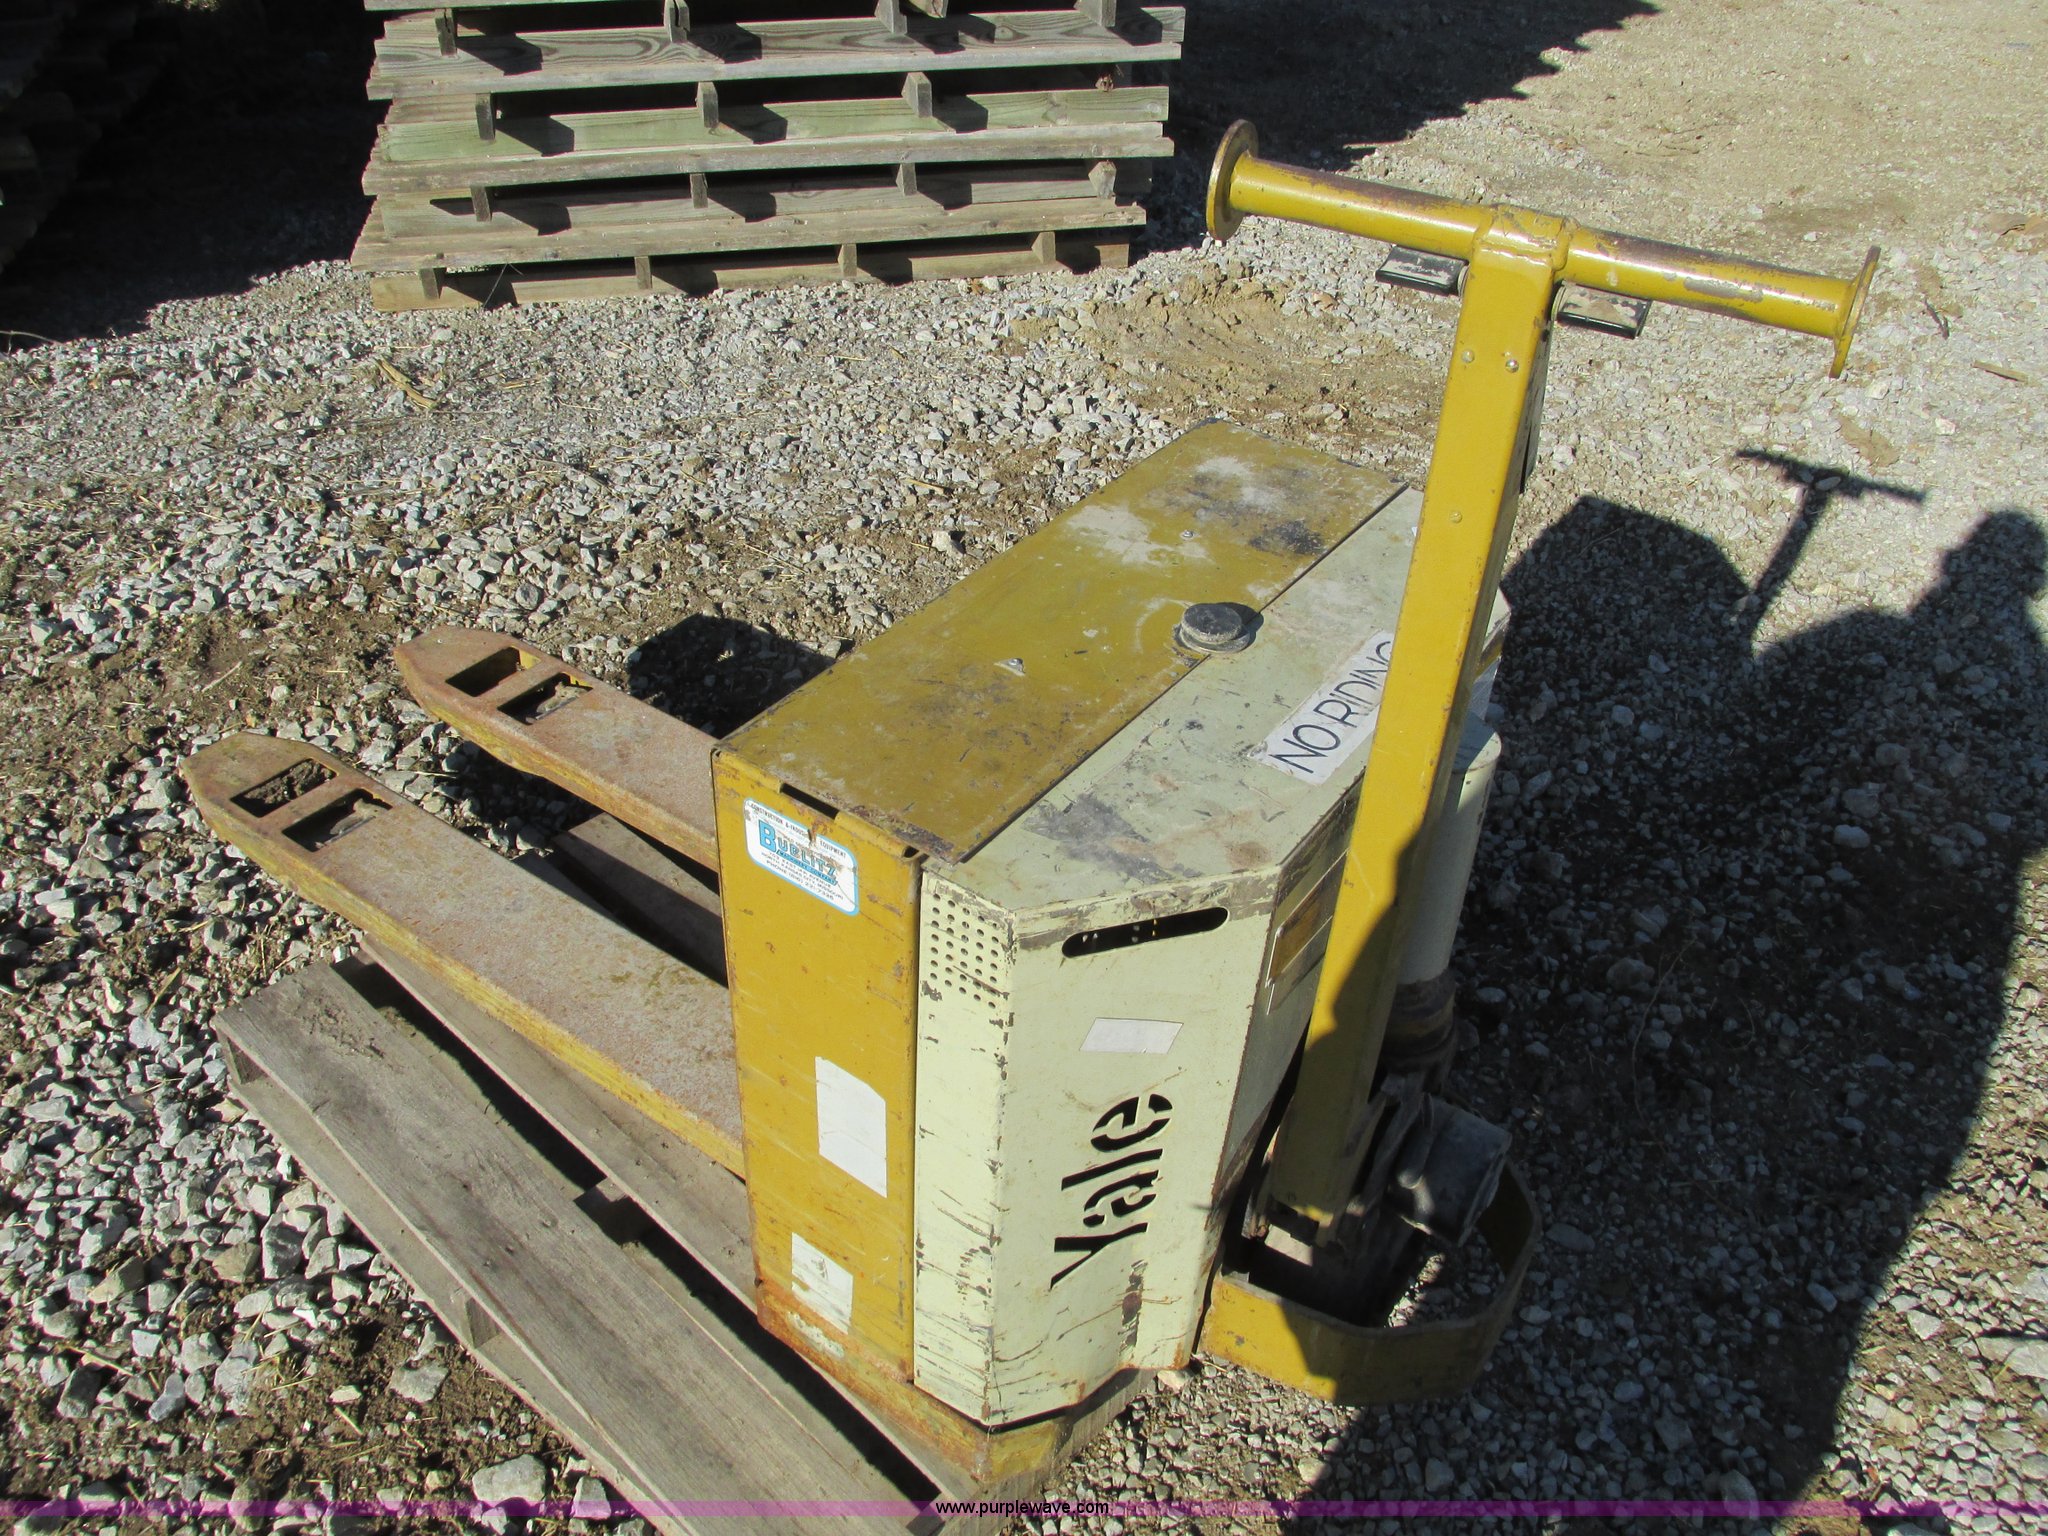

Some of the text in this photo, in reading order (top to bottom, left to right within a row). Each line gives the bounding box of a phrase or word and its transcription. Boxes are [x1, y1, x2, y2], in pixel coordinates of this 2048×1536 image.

[1268, 724, 1340, 774] NO
[758, 819, 837, 879] BUBLITZ
[819, 839, 846, 858] EQUIPMENT
[1050, 1093, 1173, 1290] Yale
